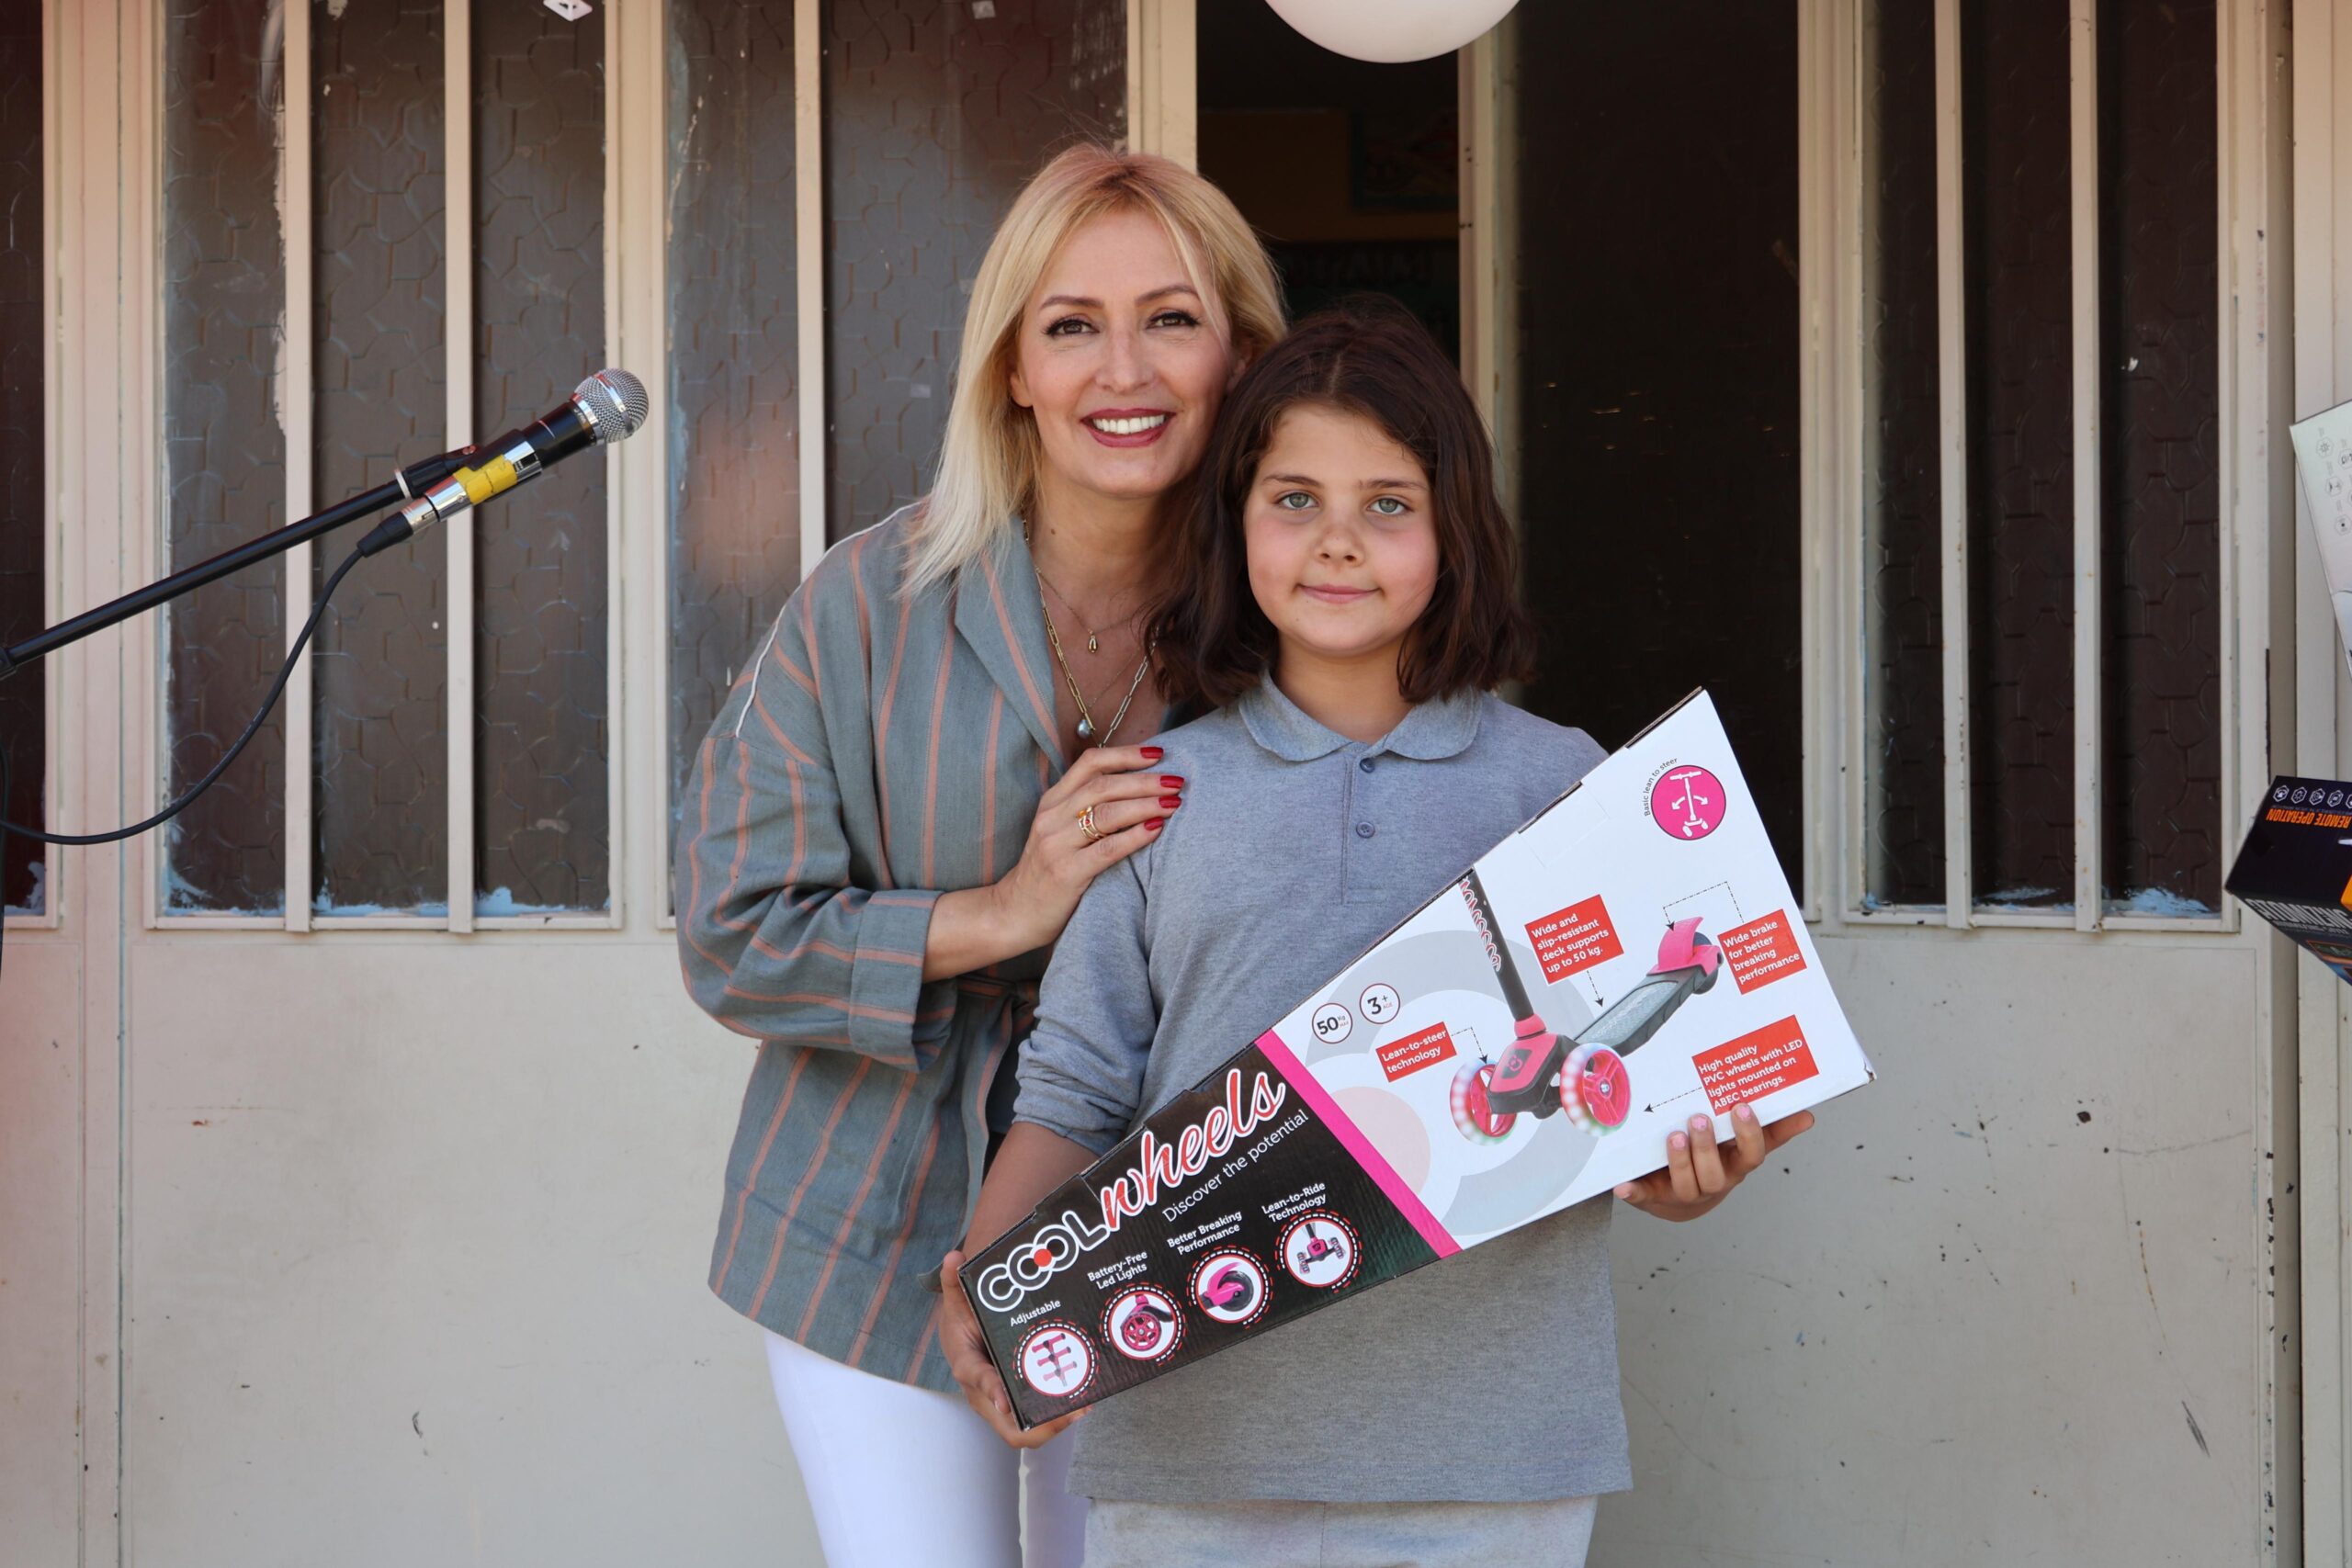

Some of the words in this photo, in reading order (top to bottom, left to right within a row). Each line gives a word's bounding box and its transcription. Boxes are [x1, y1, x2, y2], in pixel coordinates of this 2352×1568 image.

[1652, 769, 1660, 777] to
[1659, 758, 1678, 771] steer
[1643, 777, 1655, 794] lean
[1643, 795, 1651, 817] Basic
[2267, 808, 2313, 825] OPERATION
[2314, 813, 2352, 829] REMOTE
[1532, 923, 1558, 938] Wide
[1559, 913, 1578, 928] and
[1537, 919, 1600, 950] slip-resistant
[1724, 933, 1749, 948] Wide
[1749, 921, 1778, 937] brake
[1542, 947, 1566, 962] deck
[1566, 930, 1609, 952] supports
[1546, 963, 1560, 973] up
[1562, 958, 1572, 967] to
[1573, 951, 1587, 963] 50
[1587, 946, 1602, 956] kg.
[1728, 949, 1743, 960] for
[1744, 936, 1773, 953] better
[1733, 949, 1777, 972] breaking
[1738, 953, 1800, 985] performance
[1317, 1016, 1339, 1035] 50
[1382, 1029, 1447, 1062] Lean-to-steer
[1386, 1045, 1442, 1074] technology
[1698, 1059, 1724, 1075] High
[1724, 1045, 1758, 1065] quality
[1703, 1071, 1725, 1086] PVC
[1725, 1057, 1760, 1077] wheels
[1760, 1048, 1783, 1063] with
[1782, 1039, 1803, 1053] LED
[1708, 1080, 1736, 1098] lights
[1737, 1062, 1781, 1086] mounted
[1782, 1056, 1797, 1066] on
[1714, 1092, 1740, 1110] ABEC
[1740, 1076, 1786, 1098] bearings.
[1161, 1174, 1223, 1223] Discover
[1222, 1156, 1248, 1179] the
[1248, 1109, 1309, 1163] potential
[1261, 1181, 1326, 1214] Lean-to-Ride
[1268, 1194, 1327, 1223] Technology
[1166, 1229, 1197, 1248] Better
[1197, 1211, 1243, 1235] Breaking
[1177, 1224, 1240, 1256] Performance
[1087, 1251, 1148, 1282] Battery-Free
[1096, 1277, 1115, 1290] Led
[1116, 1263, 1148, 1283] Lights
[1010, 1299, 1062, 1327] Adjustable
